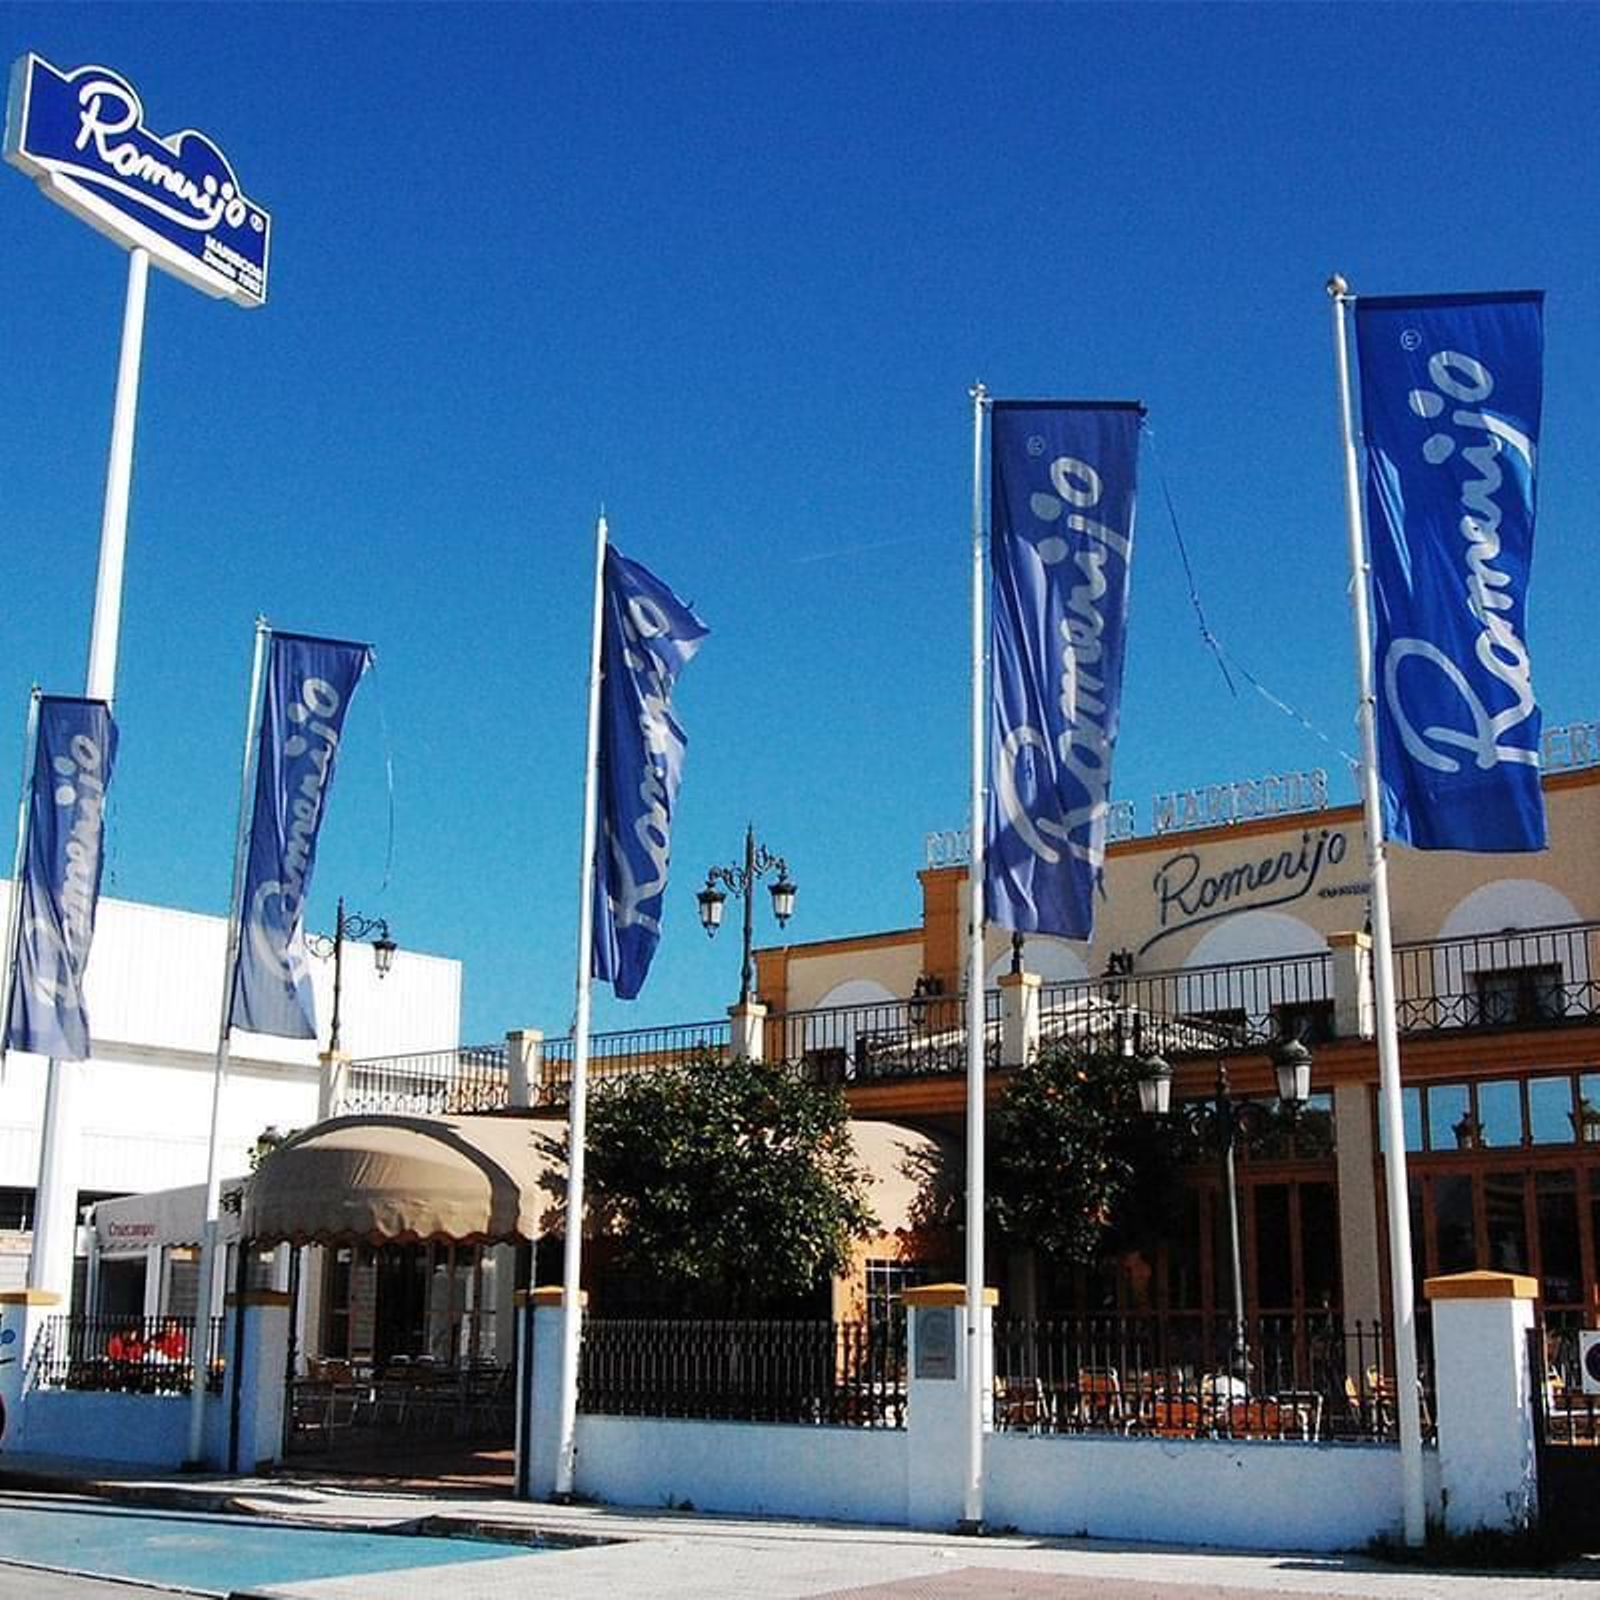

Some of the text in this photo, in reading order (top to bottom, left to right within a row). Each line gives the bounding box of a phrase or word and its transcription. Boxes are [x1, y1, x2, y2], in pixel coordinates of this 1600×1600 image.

[75, 80, 246, 231] Romerijo
[1385, 350, 1540, 774] Romerijo
[992, 456, 1134, 867] Romerijo
[1152, 767, 1328, 835] MARISCOS
[1153, 830, 1347, 926] Romerijo
